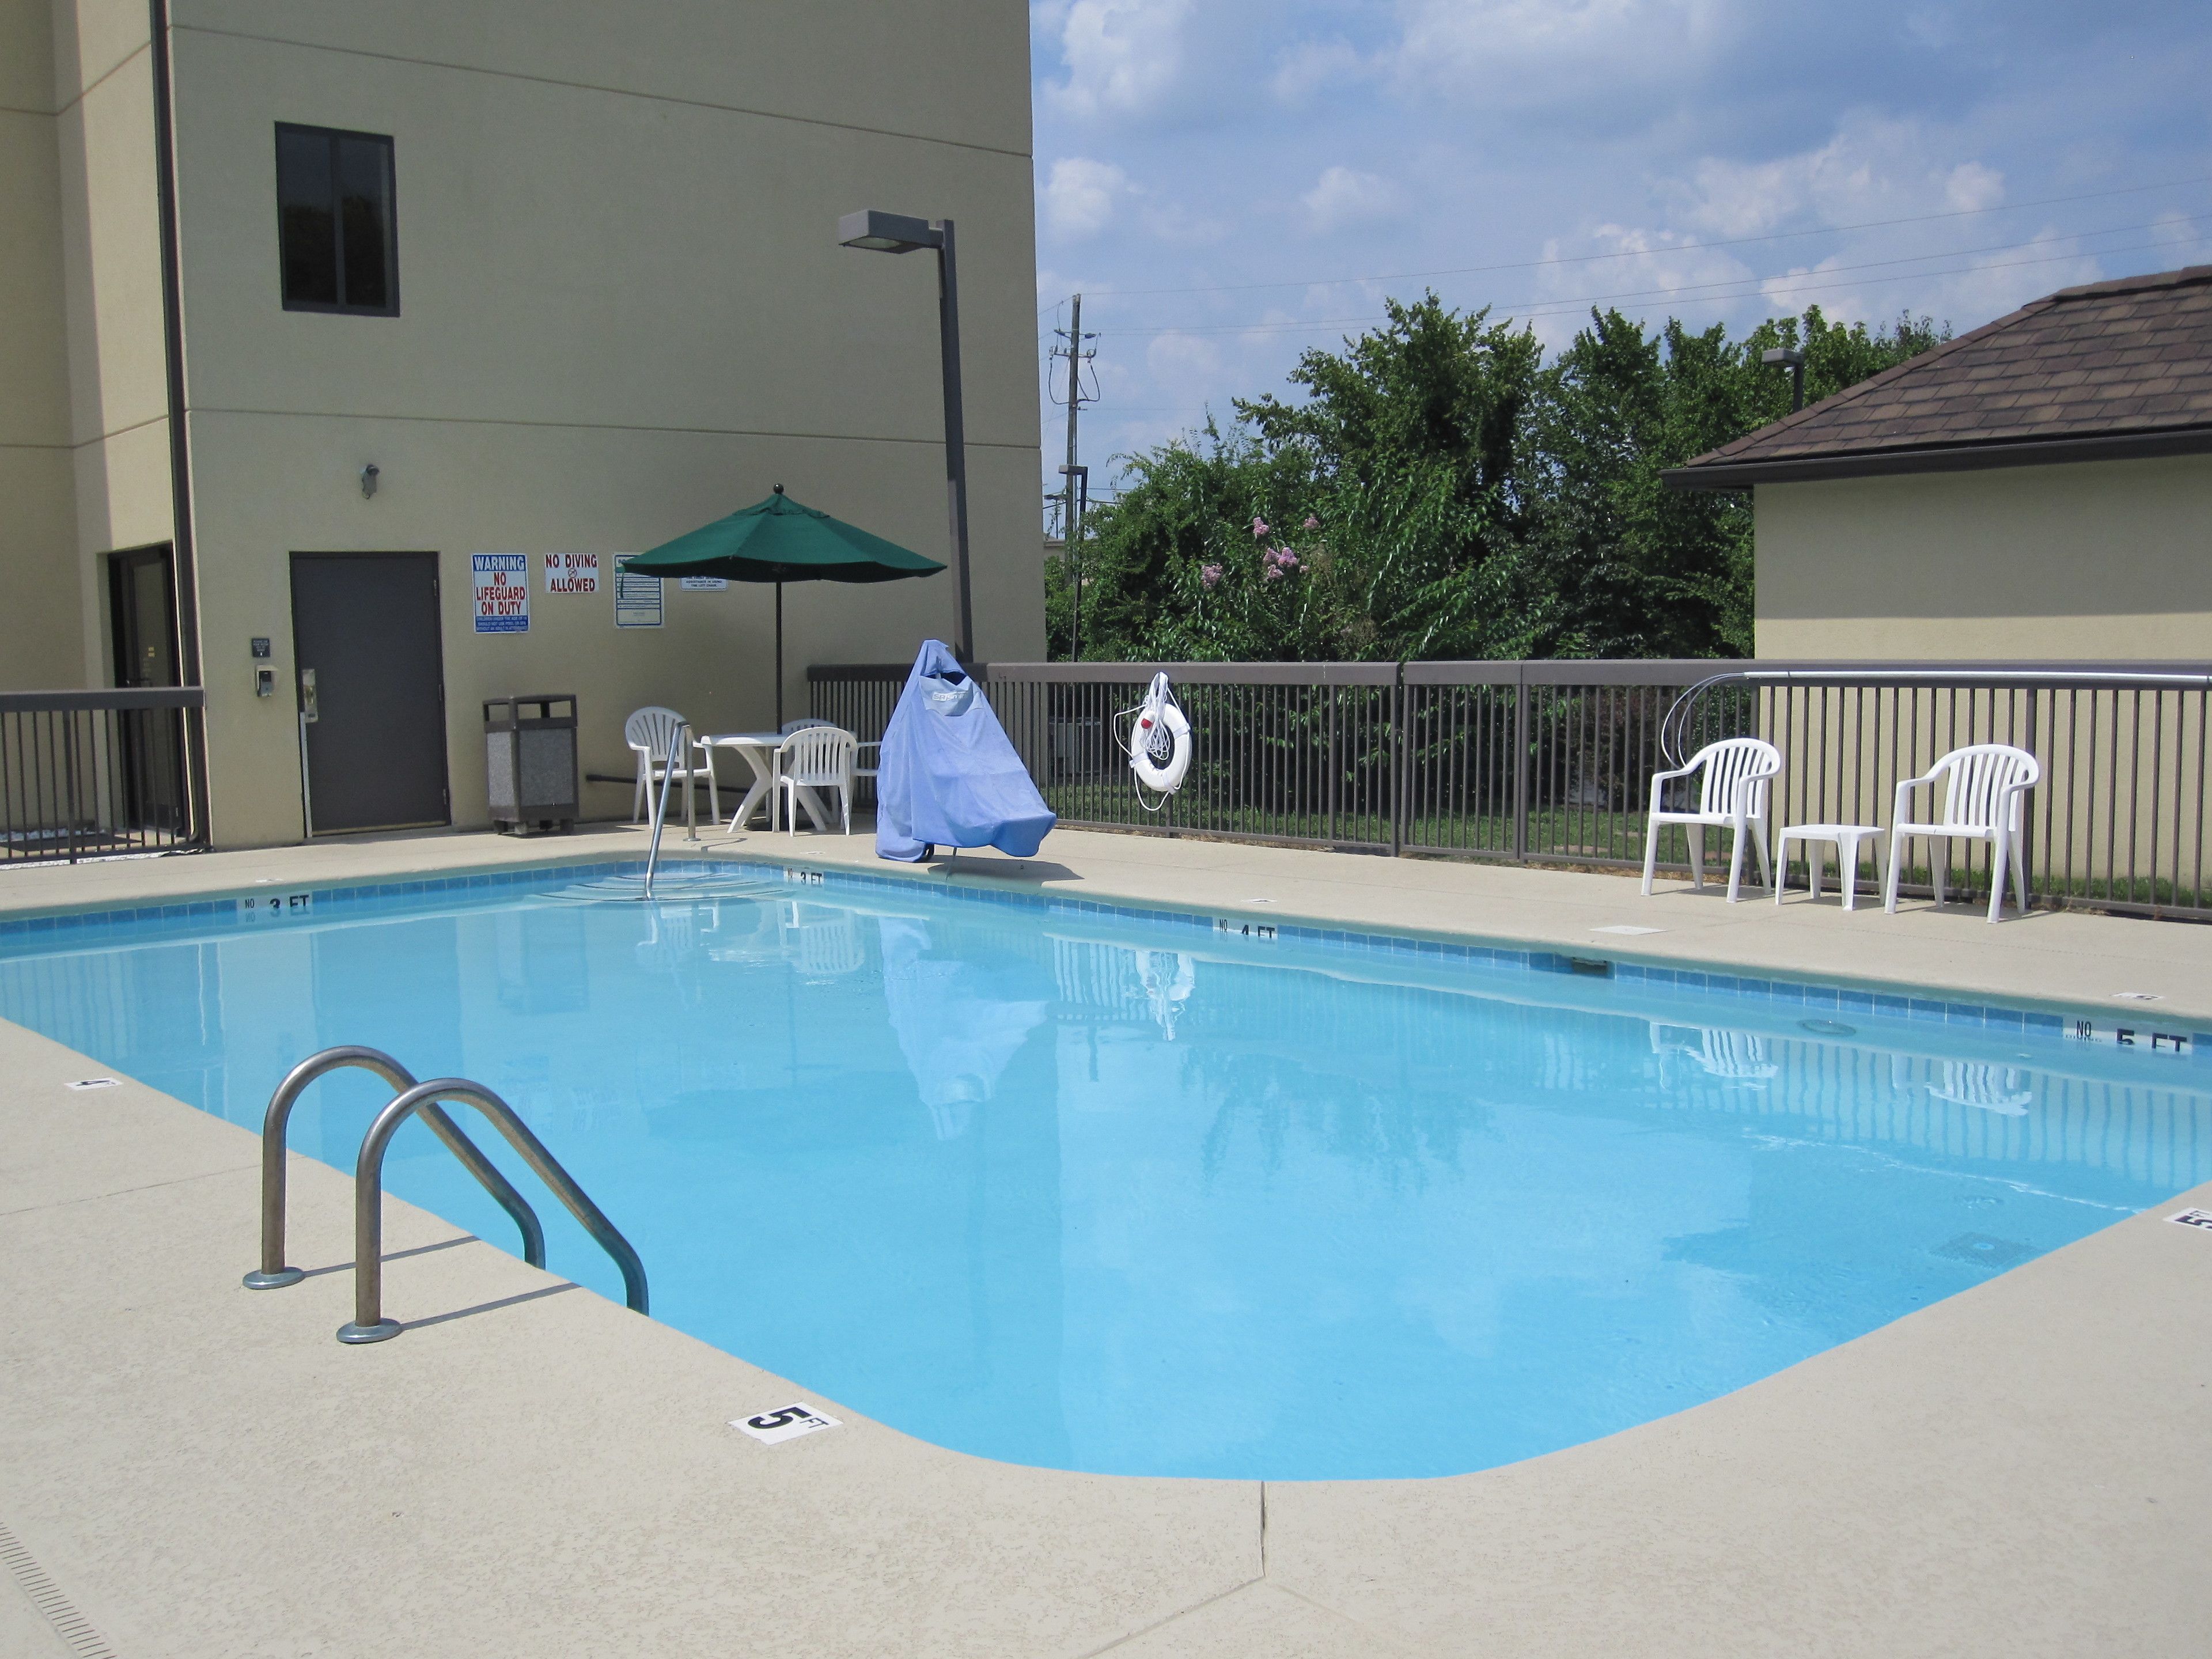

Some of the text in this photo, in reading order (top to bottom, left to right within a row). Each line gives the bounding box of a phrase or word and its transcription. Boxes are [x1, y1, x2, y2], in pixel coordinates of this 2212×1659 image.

[474, 556, 525, 571] WARNING
[546, 554, 597, 568] NO DIVING
[493, 572, 506, 585] NO
[550, 578, 595, 592] ALLOWED
[476, 586, 526, 601] LIFEGUARD
[481, 601, 521, 615] ON DUTY
[245, 898, 255, 908] NO
[1219, 919, 1228, 931] NO
[2076, 1020, 2092, 1036] NO
[747, 1406, 830, 1430] 5 FT
